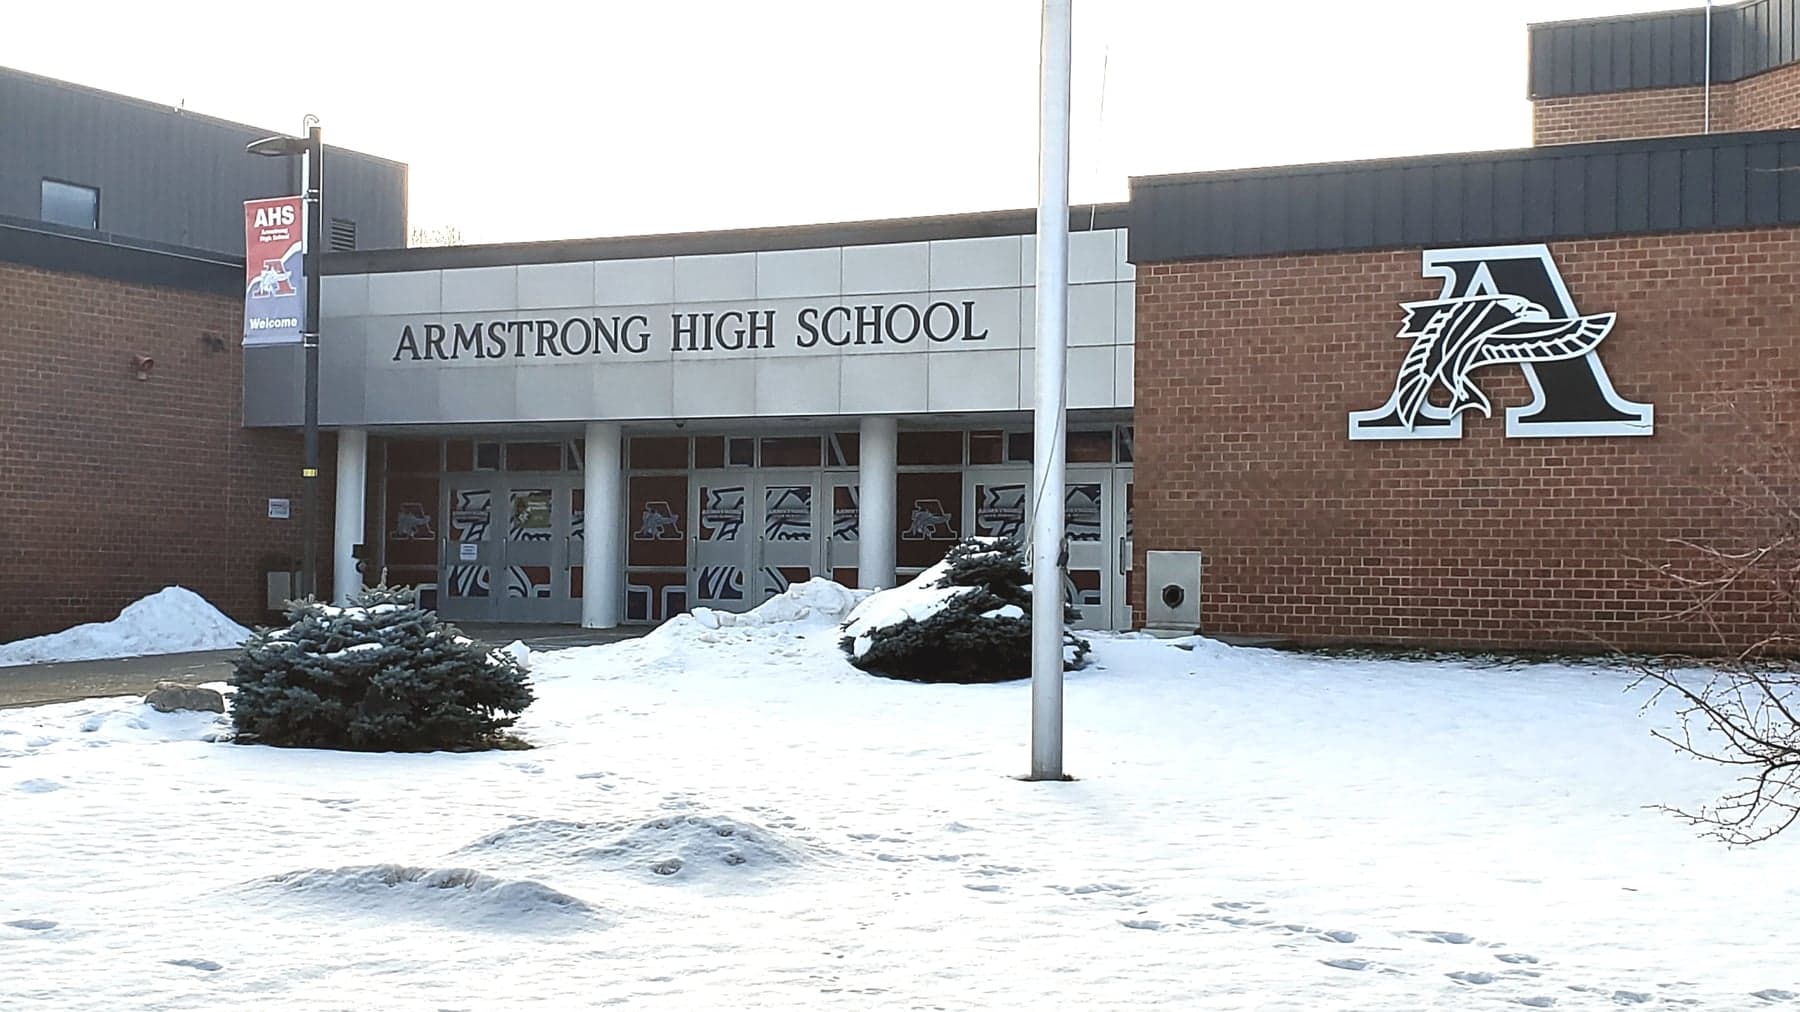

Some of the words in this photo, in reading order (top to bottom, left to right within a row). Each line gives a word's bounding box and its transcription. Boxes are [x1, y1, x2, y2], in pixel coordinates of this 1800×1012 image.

[254, 205, 295, 228] AHS
[250, 317, 298, 329] Welcome
[393, 315, 651, 361] ARMSTRONG
[671, 310, 776, 352] HIGH
[797, 301, 988, 348] SCHOOL
